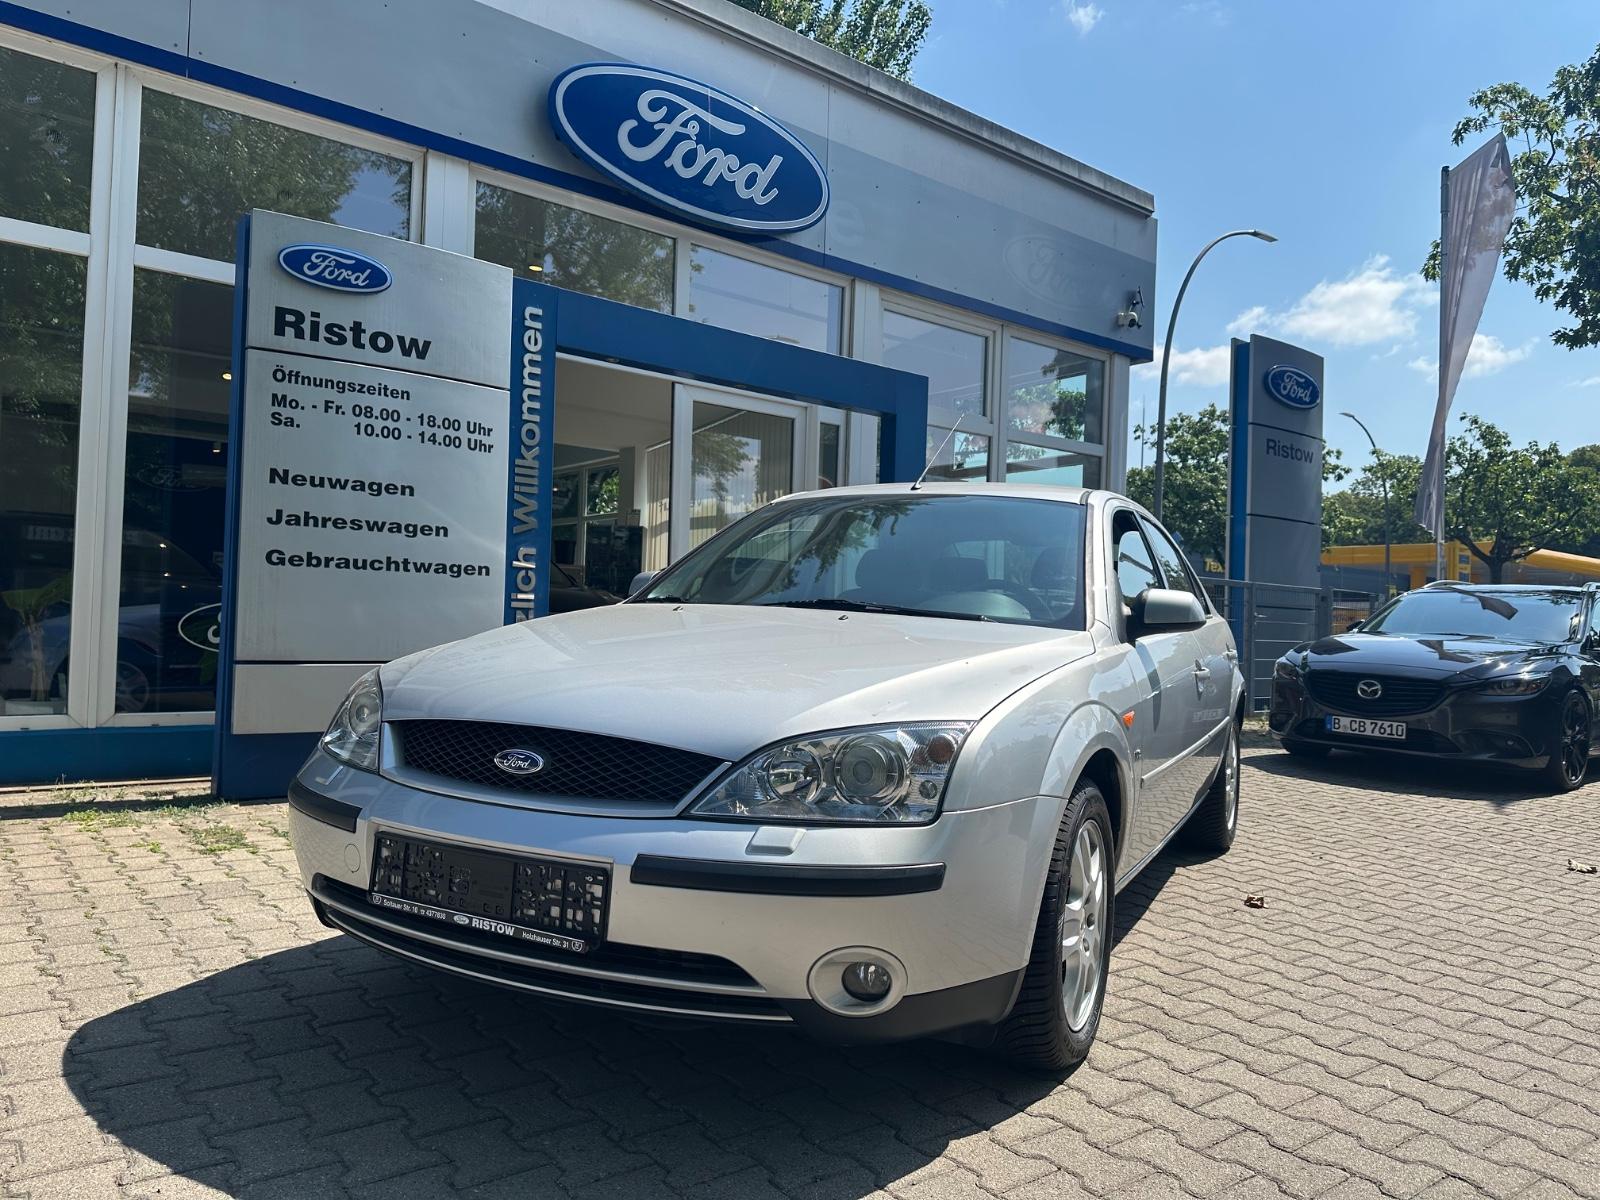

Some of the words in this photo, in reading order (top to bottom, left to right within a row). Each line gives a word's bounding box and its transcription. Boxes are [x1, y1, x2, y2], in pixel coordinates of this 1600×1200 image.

[617, 89, 784, 206] Ford
[302, 251, 372, 287] Ford
[273, 305, 432, 361] Ristow
[272, 364, 411, 401] Öffnungszeiten
[1280, 372, 1313, 402] Ford
[271, 393, 305, 410] Mo.
[324, 400, 346, 415] Fr.
[352, 404, 401, 422] 08.00
[417, 413, 461, 431] 18.00
[466, 420, 494, 437] Uhr
[513, 305, 543, 534] Willkommen
[270, 411, 301, 428] Sa.
[354, 422, 401, 440] 10.00
[418, 431, 462, 448] 14.00
[467, 437, 494, 453] Uhr
[1265, 438, 1314, 464] Ristow
[269, 468, 415, 497] Neuwagen
[266, 509, 449, 538] Jahreswagen
[265, 549, 490, 577] Gebrauchtwagen
[1333, 717, 1341, 730] B
[1349, 720, 1367, 733] CB
[1370, 722, 1405, 737] 7610
[503, 753, 531, 769] Ford
[472, 918, 515, 936] RISTOW
[522, 931, 552, 945] Holzhauser
